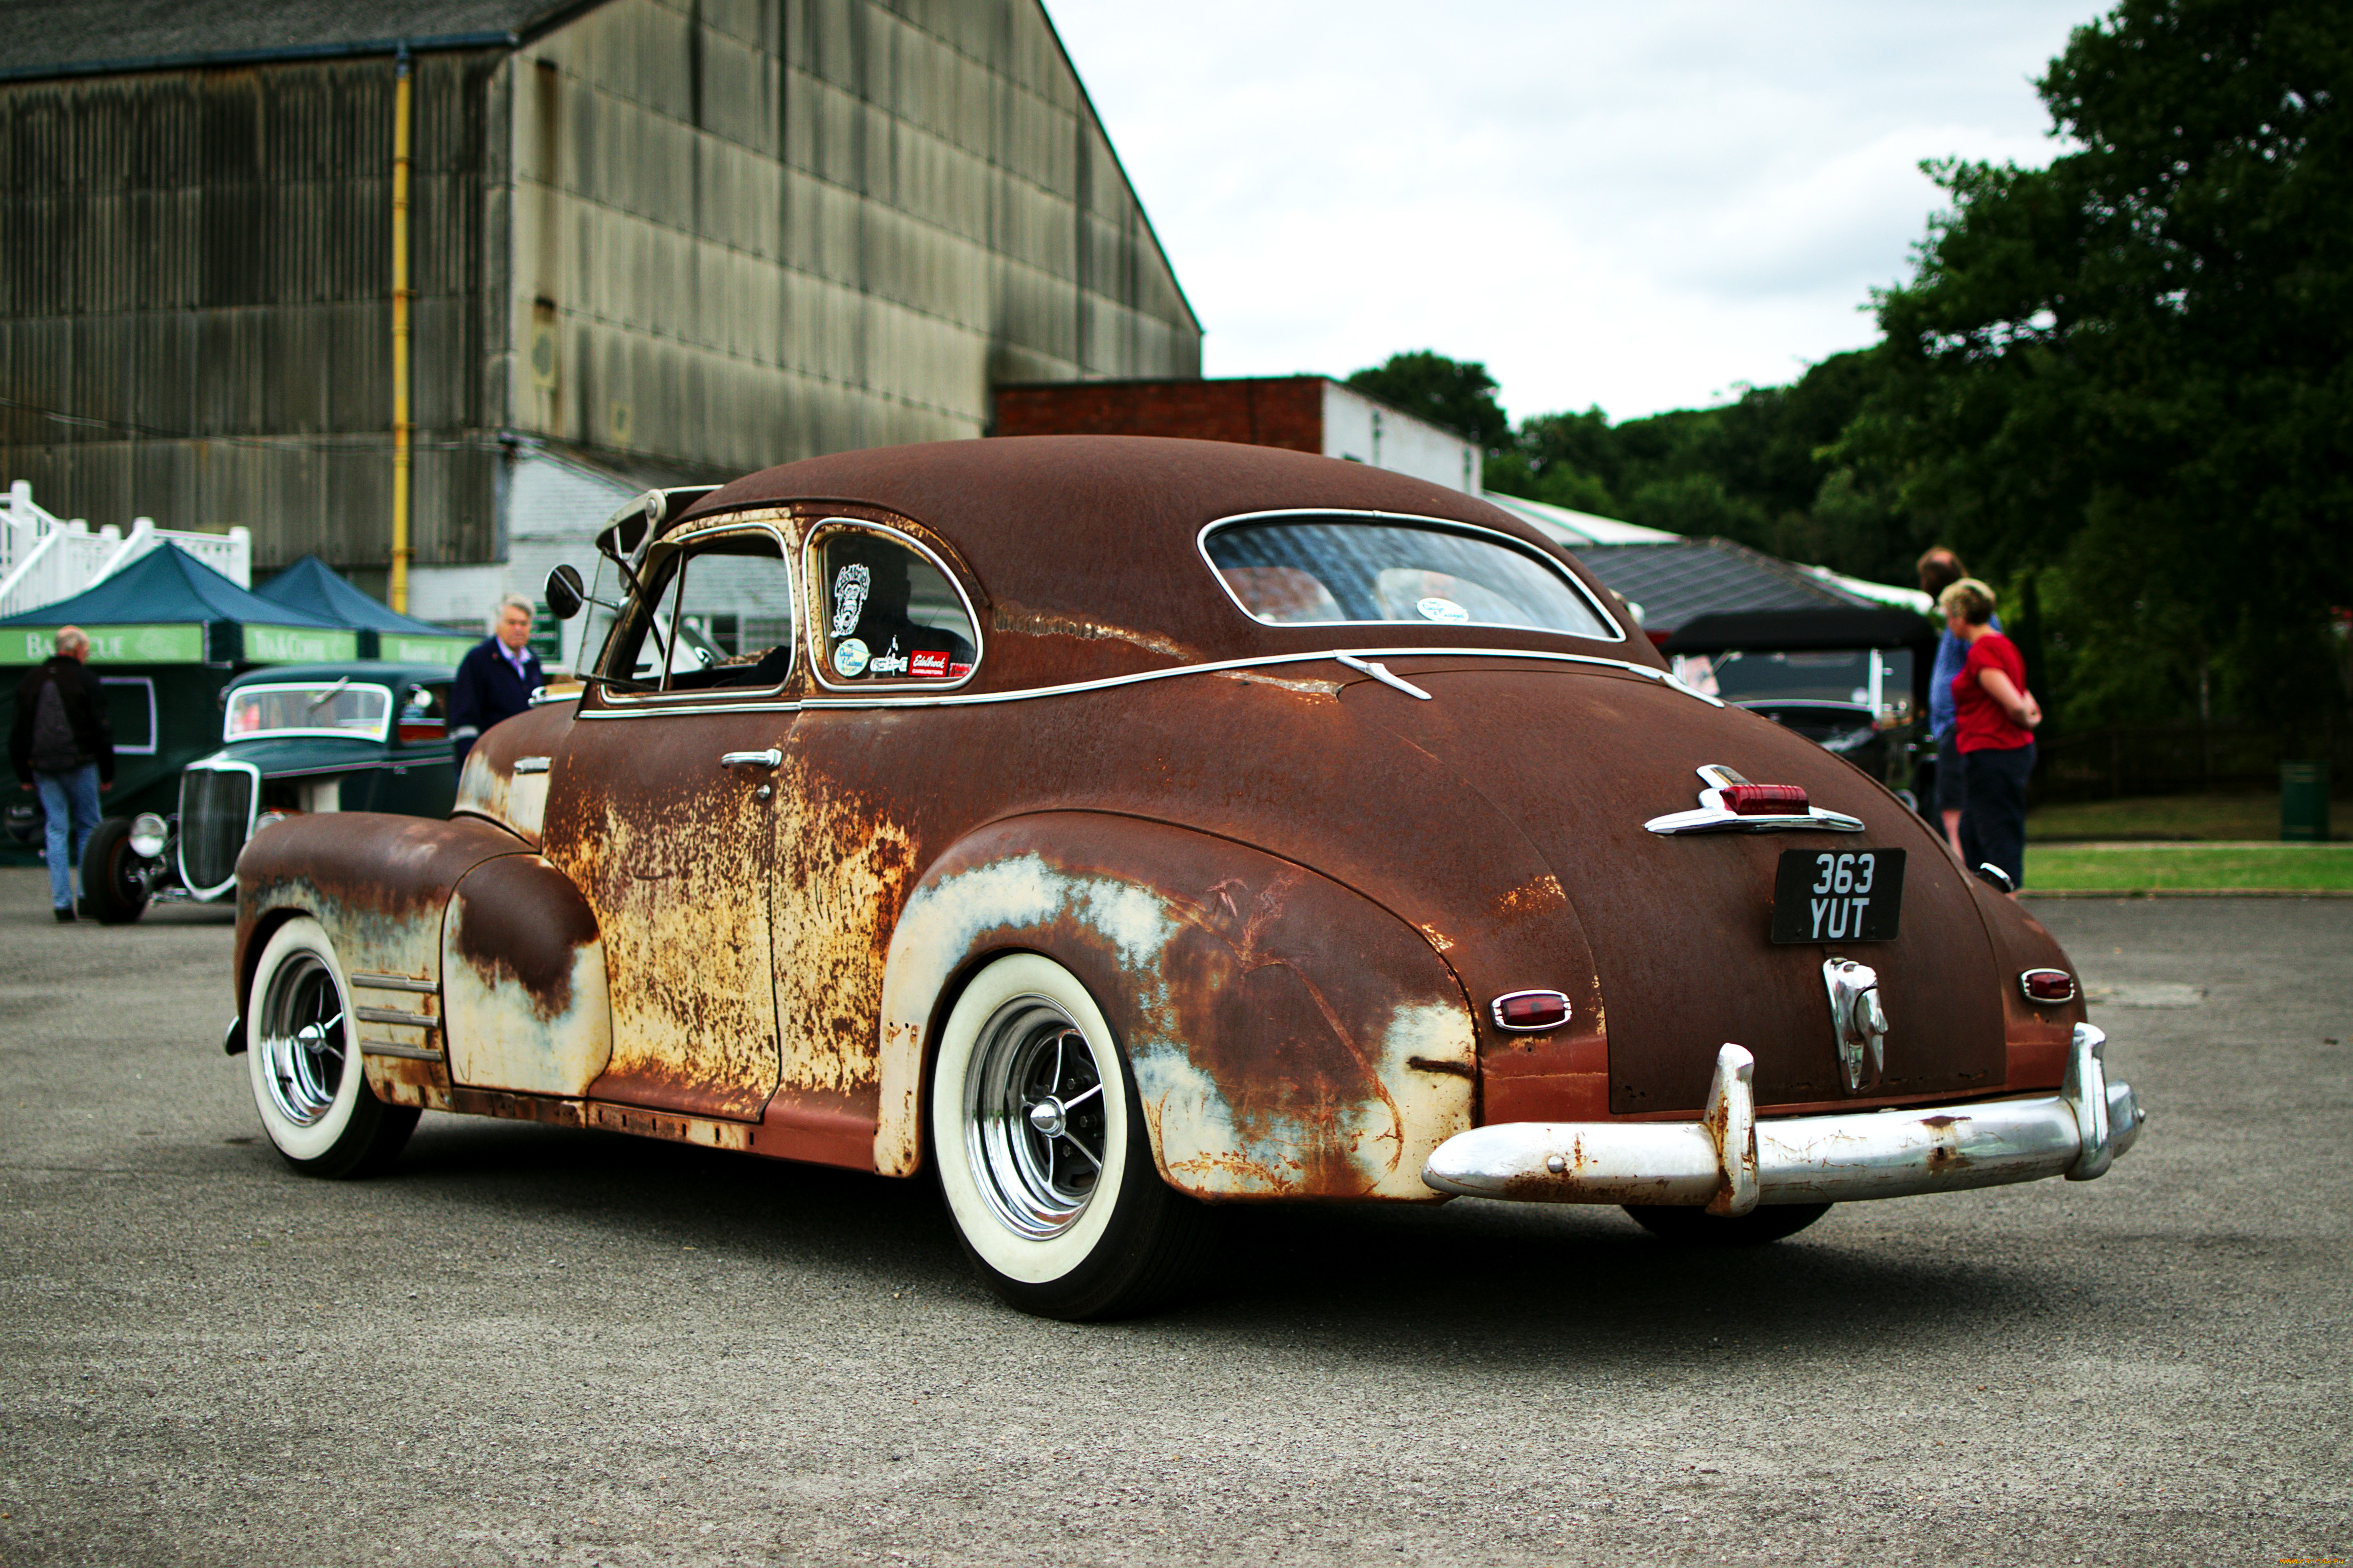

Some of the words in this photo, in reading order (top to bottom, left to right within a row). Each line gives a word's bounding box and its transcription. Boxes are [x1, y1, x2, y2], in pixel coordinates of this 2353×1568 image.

[913, 654, 945, 669] Edelbrock
[1813, 854, 1875, 894] 363
[1811, 898, 1870, 938] YUT
